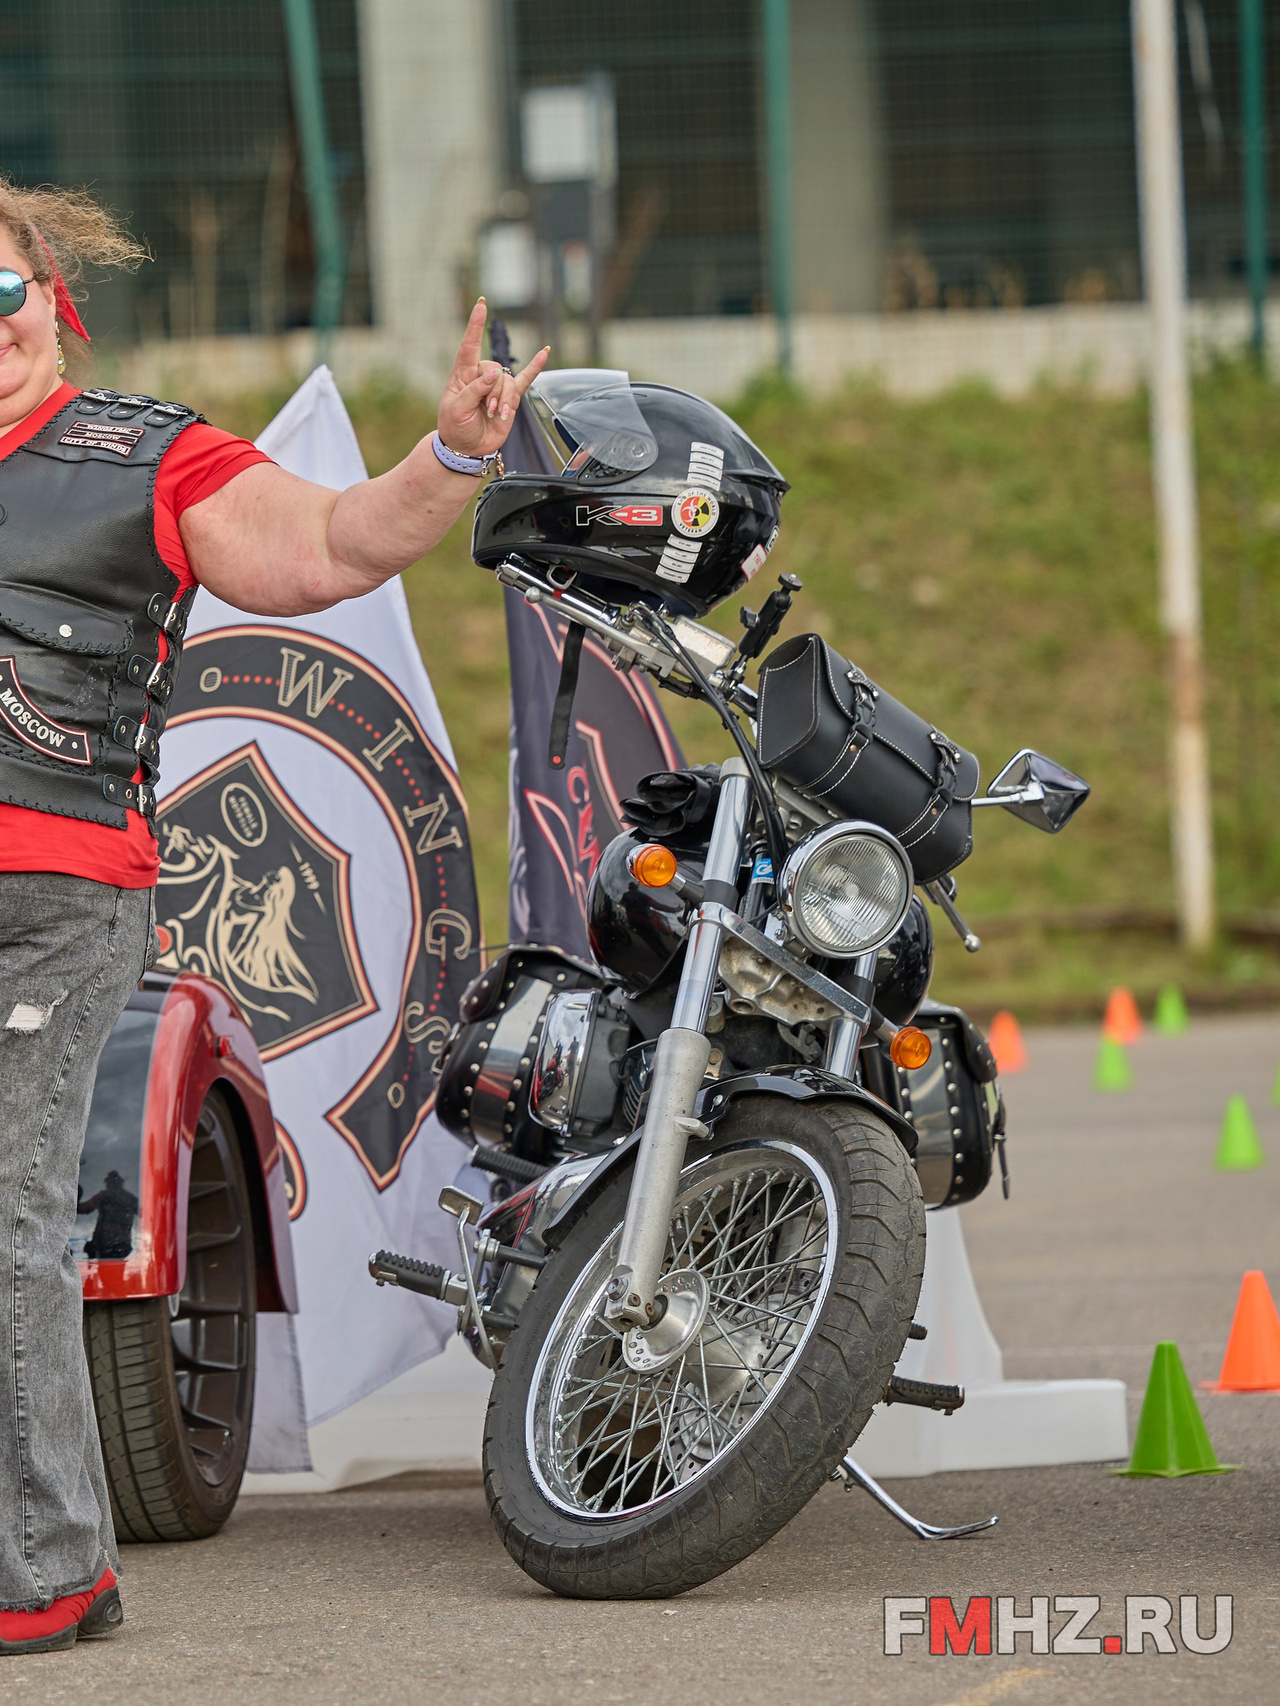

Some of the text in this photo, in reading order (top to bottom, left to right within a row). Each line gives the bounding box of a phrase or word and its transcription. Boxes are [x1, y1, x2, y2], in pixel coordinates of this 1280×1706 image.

[85, 432, 121, 440] MOSCOW
[707, 495, 716, 517] WORLD
[679, 523, 703, 534] VETERAN
[277, 647, 472, 1054] WINGS
[298, 862, 320, 890] 1999
